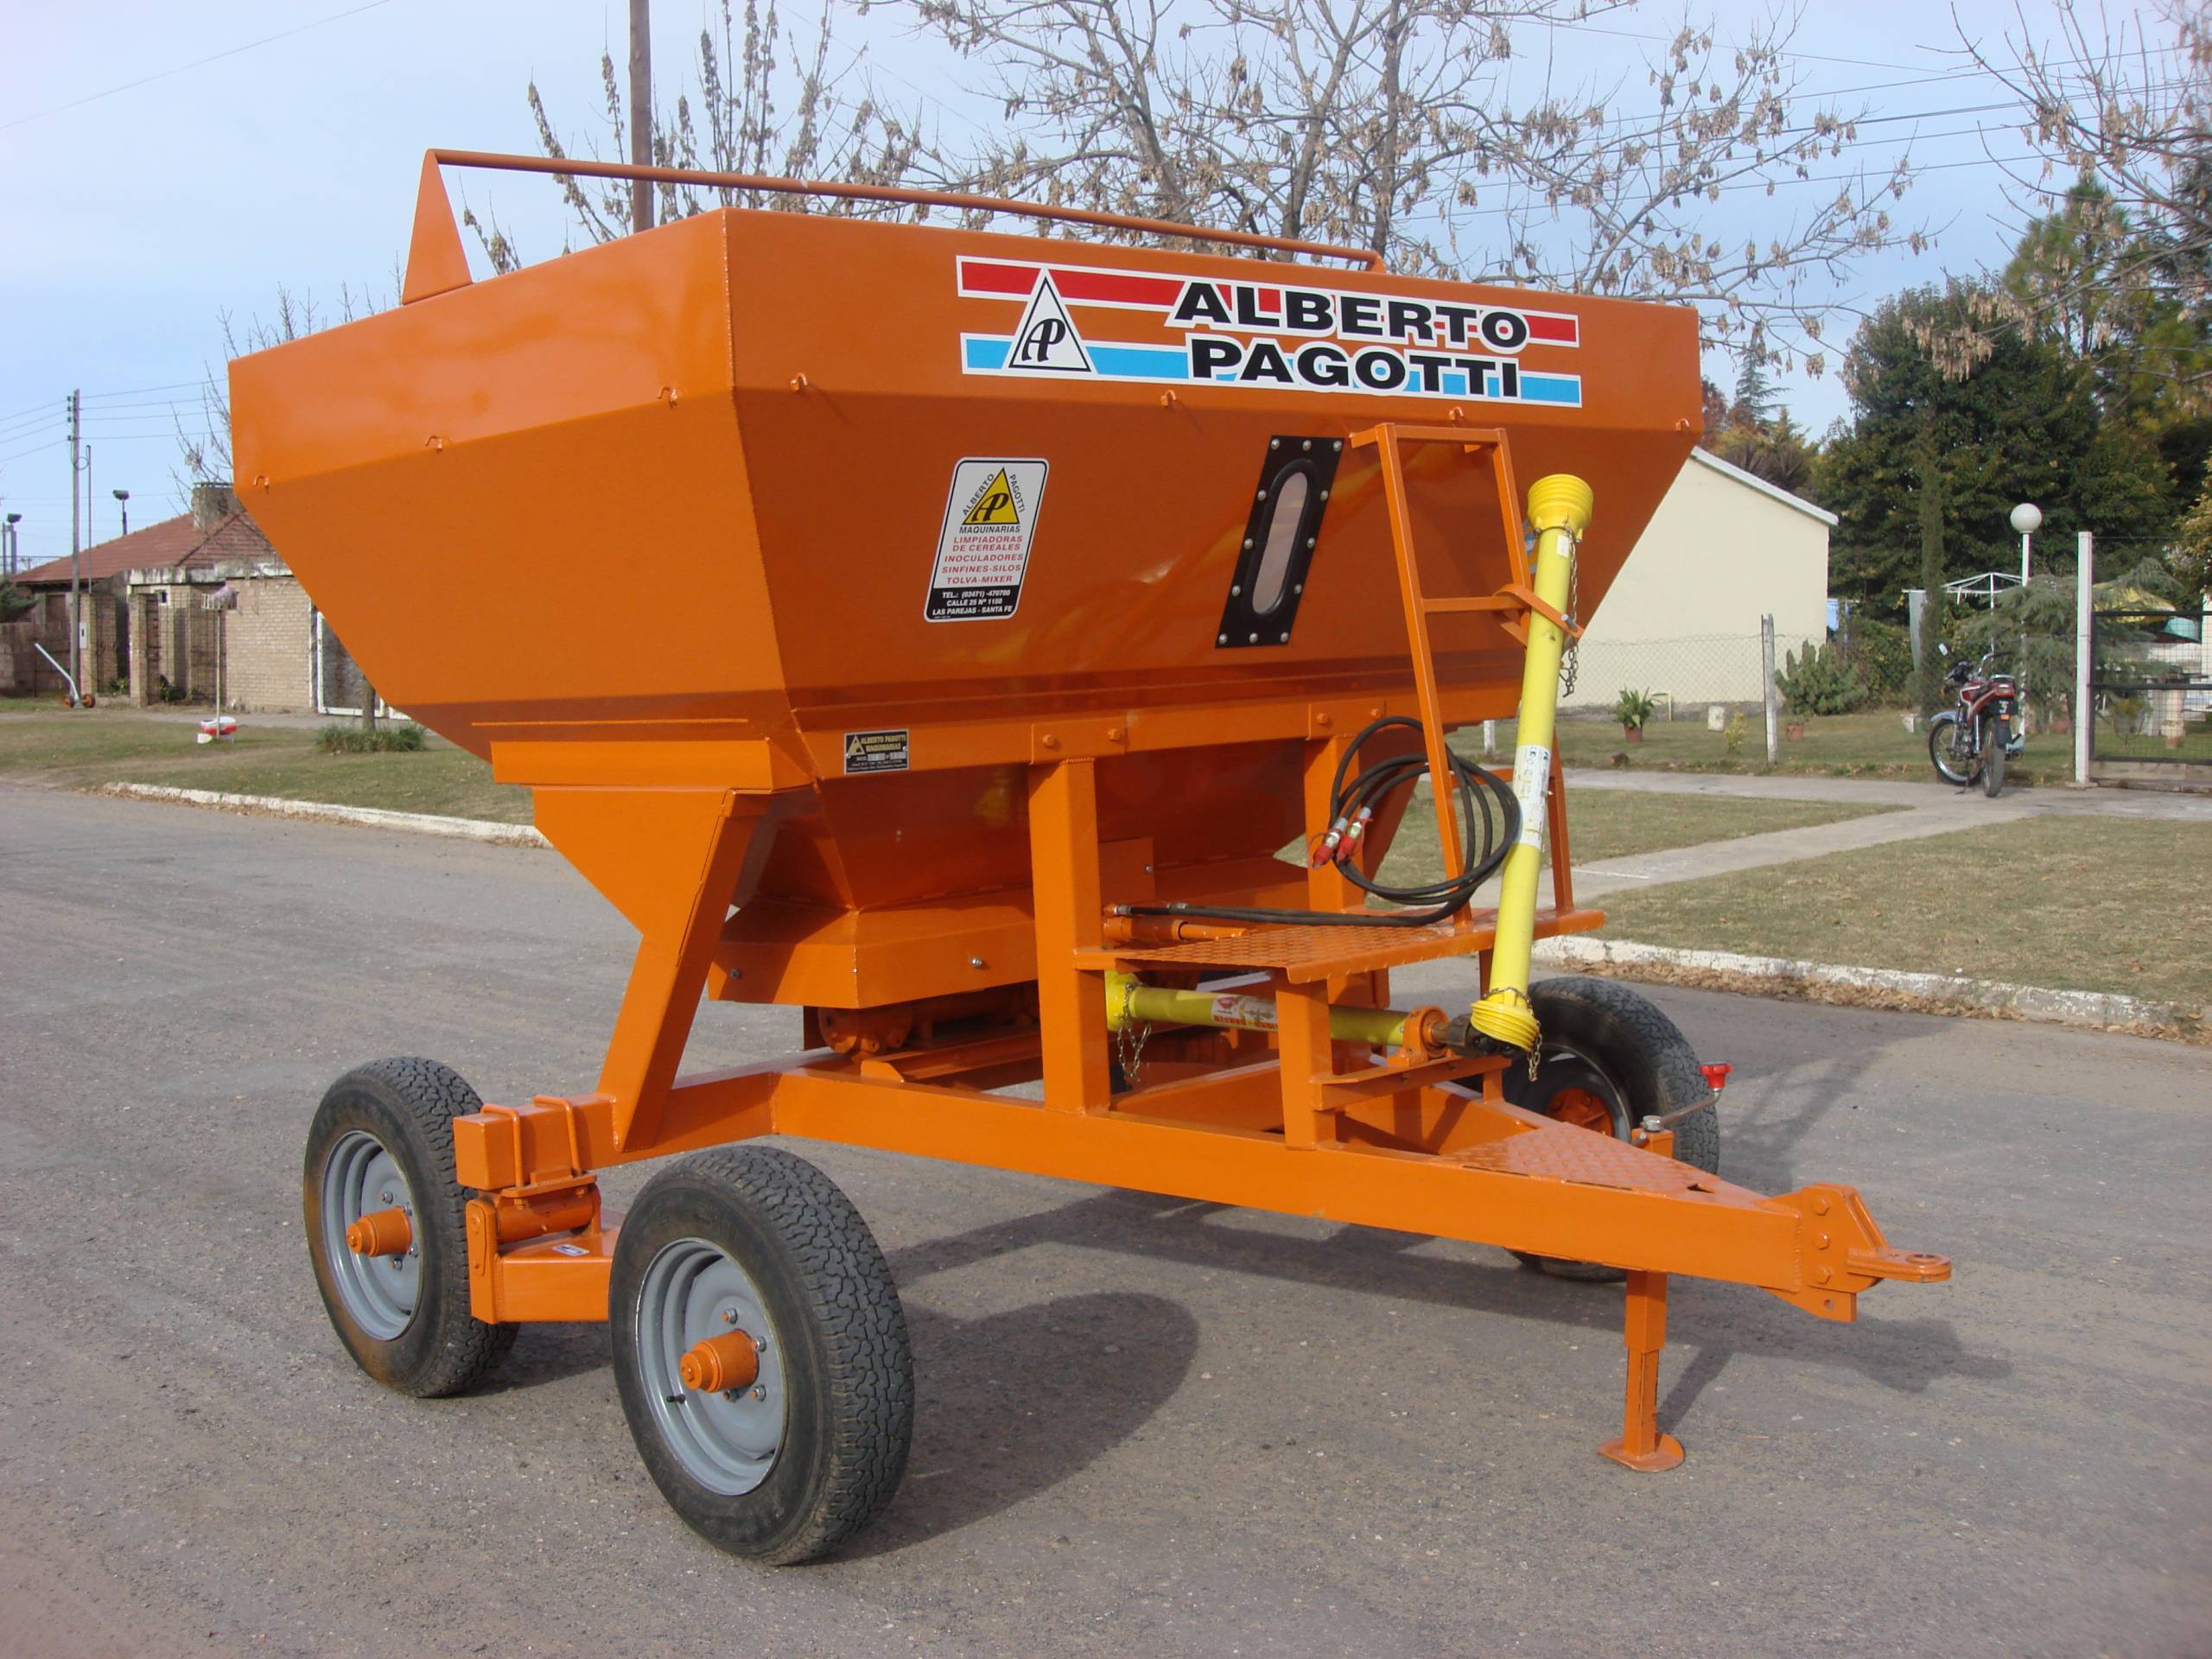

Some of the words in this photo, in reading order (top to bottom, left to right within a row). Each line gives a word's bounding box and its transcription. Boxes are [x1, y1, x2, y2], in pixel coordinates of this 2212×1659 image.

[1174, 282, 1528, 348] ALBERTO
[1191, 339, 1518, 397] PAGOTTI
[963, 474, 995, 516] ALBERTO
[1009, 474, 1026, 513] PAGOTTI
[959, 525, 1021, 534] MAQUINARIAS
[953, 536, 1023, 544] LIMPIADORAS
[969, 543, 1020, 552] CEREALES
[944, 553, 1023, 563] INOCULADORES
[942, 564, 1021, 574] SINFINES-SILOS
[947, 575, 1013, 585] TOLVA-MIXER
[947, 607, 976, 615] PAREJAS
